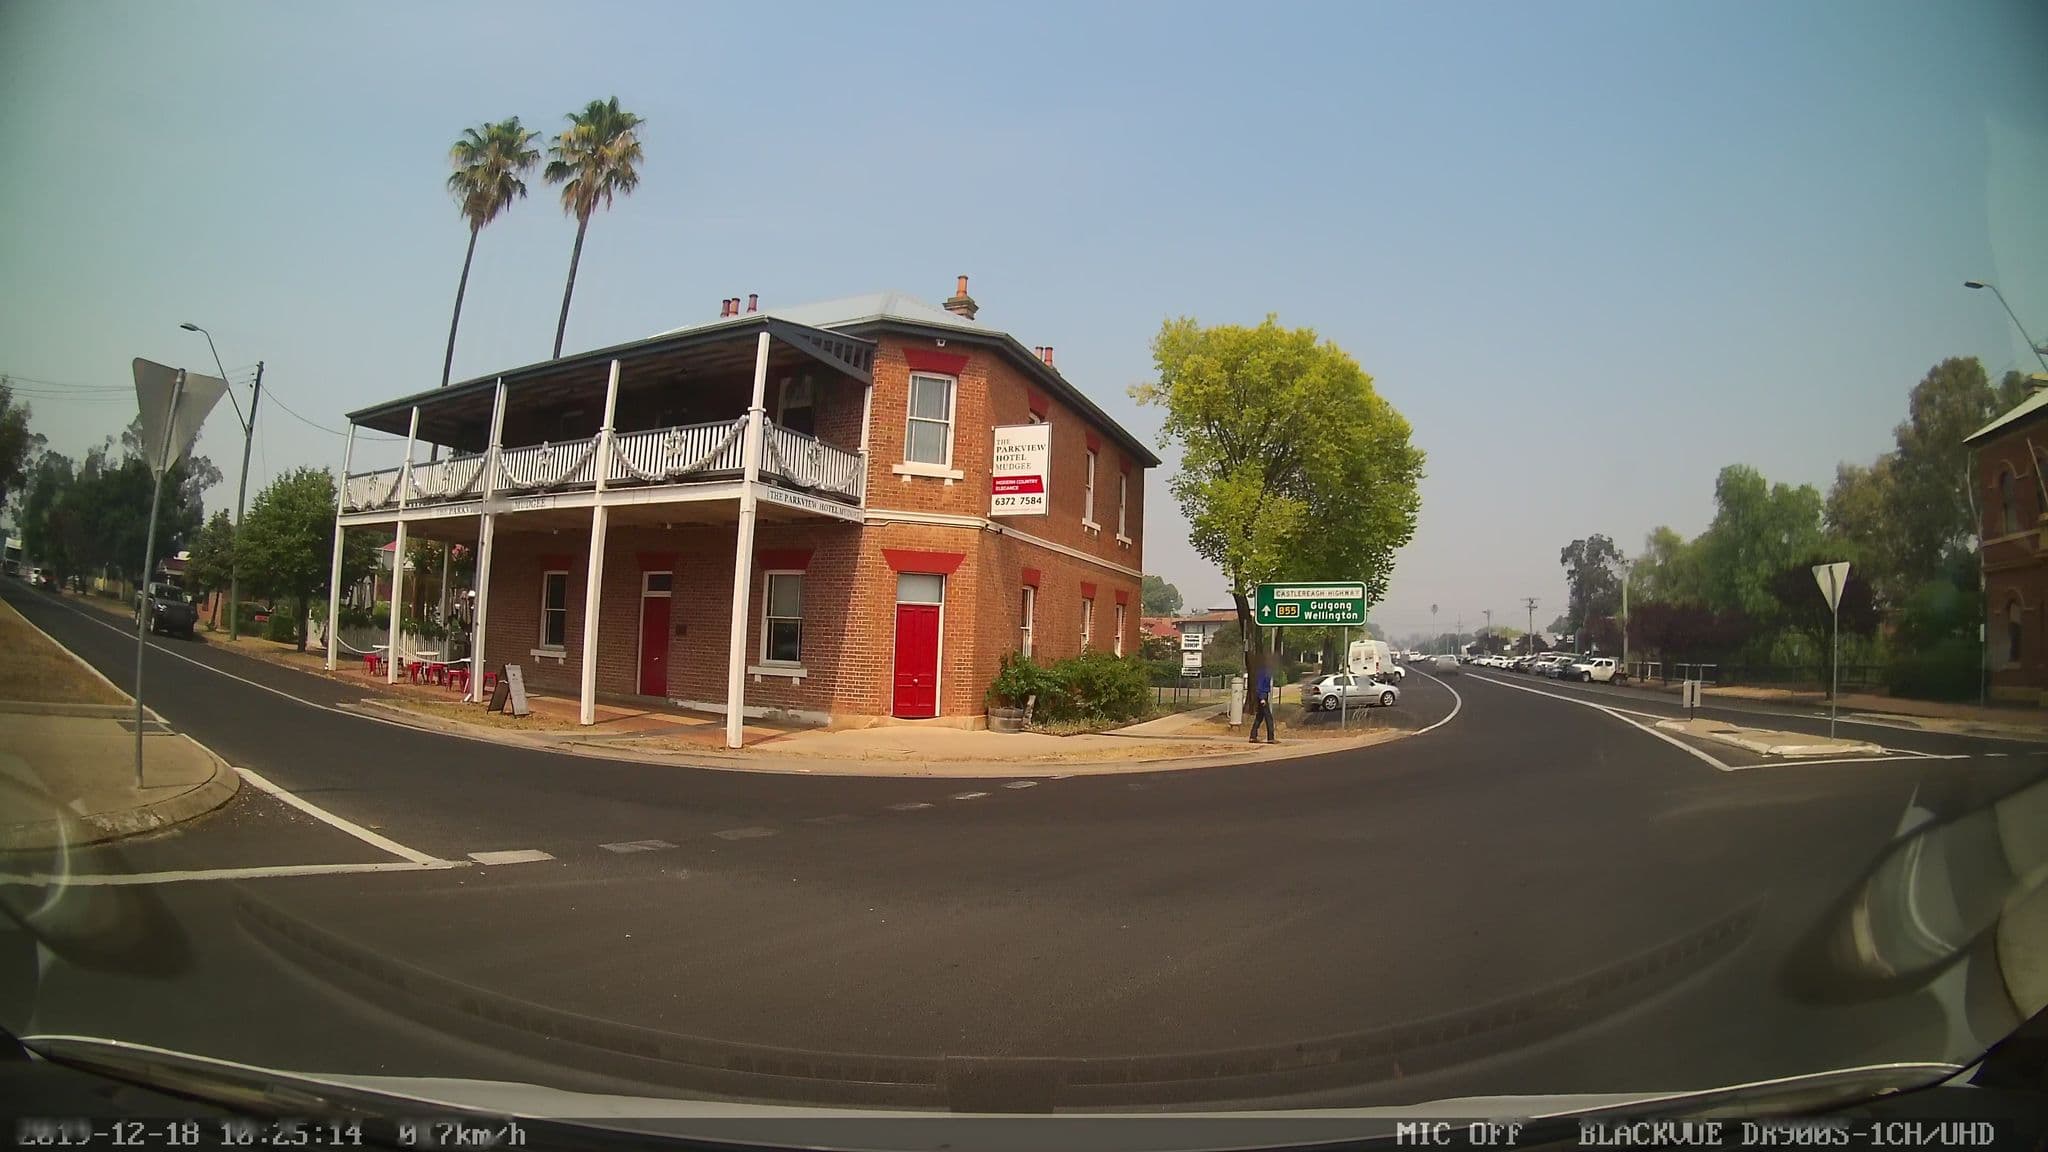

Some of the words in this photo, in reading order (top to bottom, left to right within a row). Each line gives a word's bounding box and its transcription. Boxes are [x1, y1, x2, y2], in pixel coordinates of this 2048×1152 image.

[996, 444, 1046, 453] PARKVIEW
[996, 454, 1026, 462] HOTEL
[996, 462, 1032, 470] MUDGEE
[770, 490, 783, 500] THE
[784, 493, 817, 509] PARKVIEW
[819, 502, 838, 515] HOTEL
[995, 497, 1015, 506] 6372
[1020, 496, 1042, 505] 7584
[1276, 590, 1325, 598] CASTLEREAGH
[1327, 589, 1361, 597] HIGHWAY
[1278, 606, 1297, 615] B55
[1310, 601, 1352, 612] Gulgong
[1304, 611, 1358, 622] Wellington
